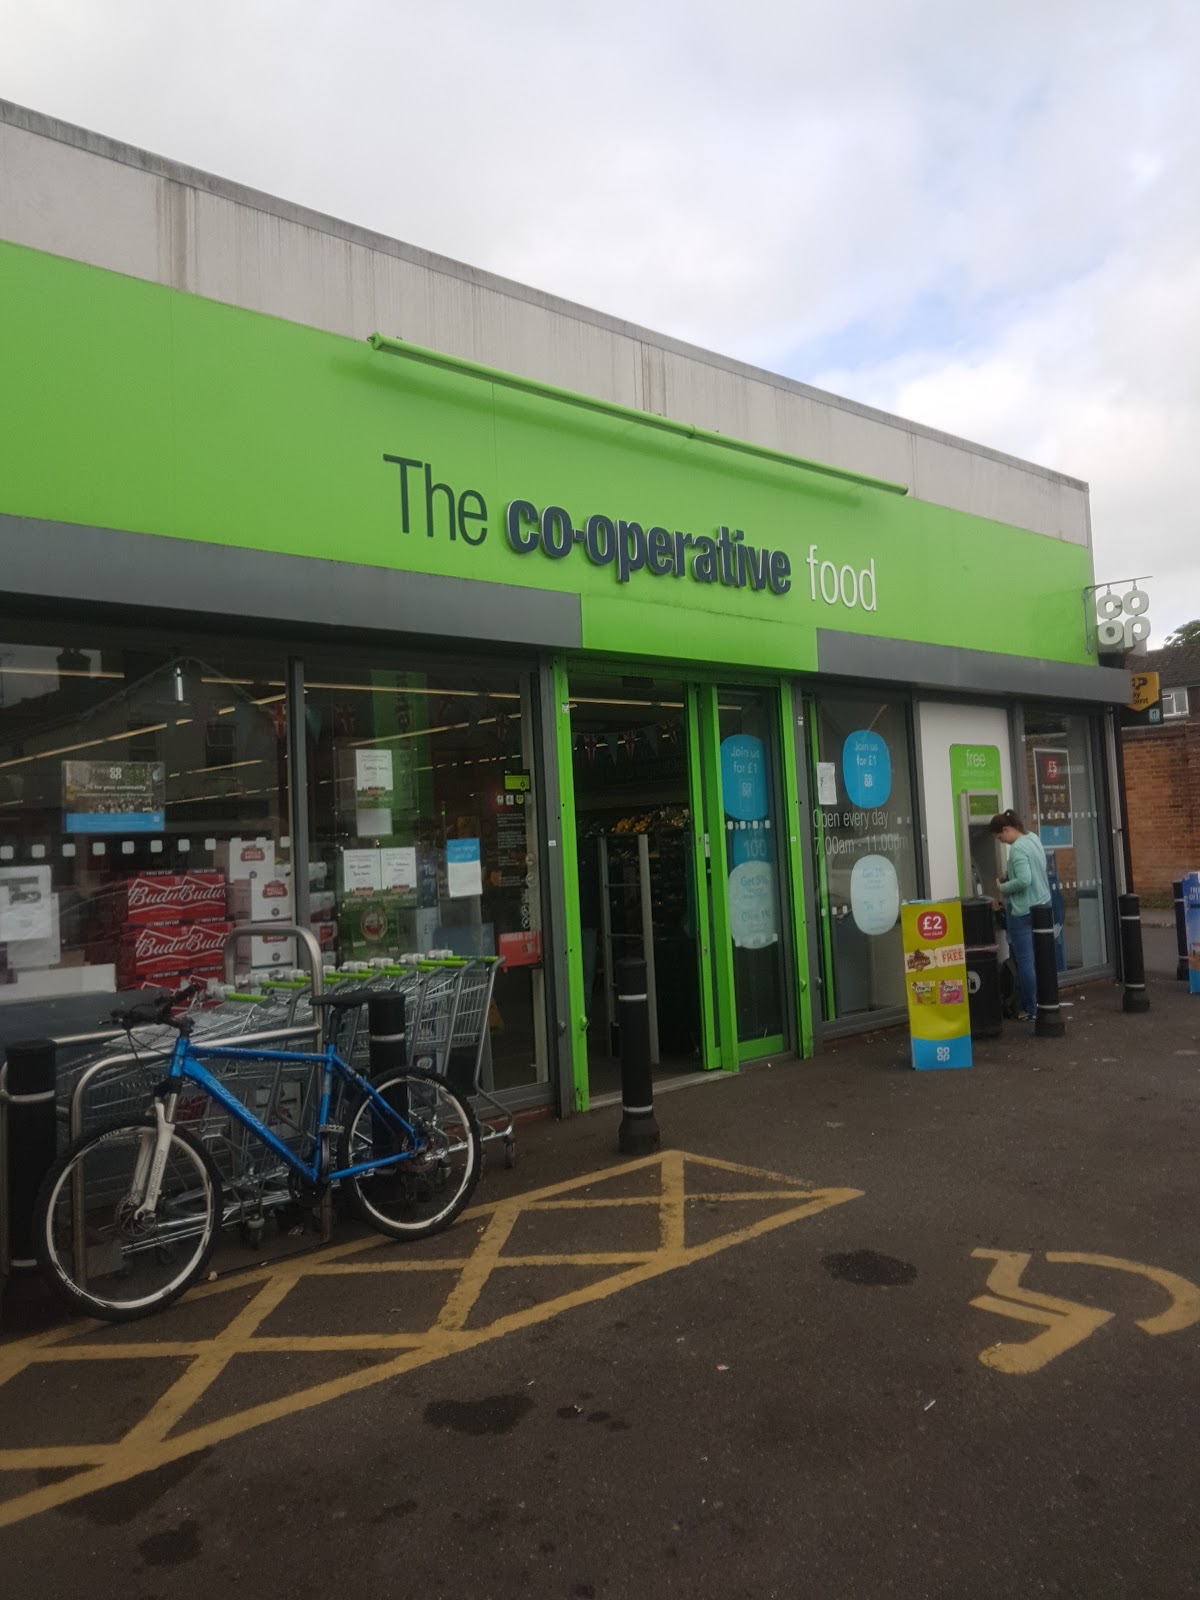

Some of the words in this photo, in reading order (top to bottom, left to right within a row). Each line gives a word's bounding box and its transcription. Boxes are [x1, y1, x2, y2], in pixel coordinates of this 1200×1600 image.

[383, 453, 488, 546] The
[506, 499, 792, 595] co-operative
[806, 545, 877, 611] food
[731, 746, 748, 758] Join
[750, 749, 760, 759] us
[855, 741, 869, 752] Join
[856, 754, 866, 766] for
[966, 749, 986, 767] free
[733, 761, 745, 773] for
[748, 762, 758, 774] £1
[813, 809, 841, 831] Open
[843, 811, 870, 832] every
[871, 808, 889, 829] day
[814, 835, 855, 856] 7.00am
[922, 916, 942, 930] £2
[942, 951, 964, 963] FREE
